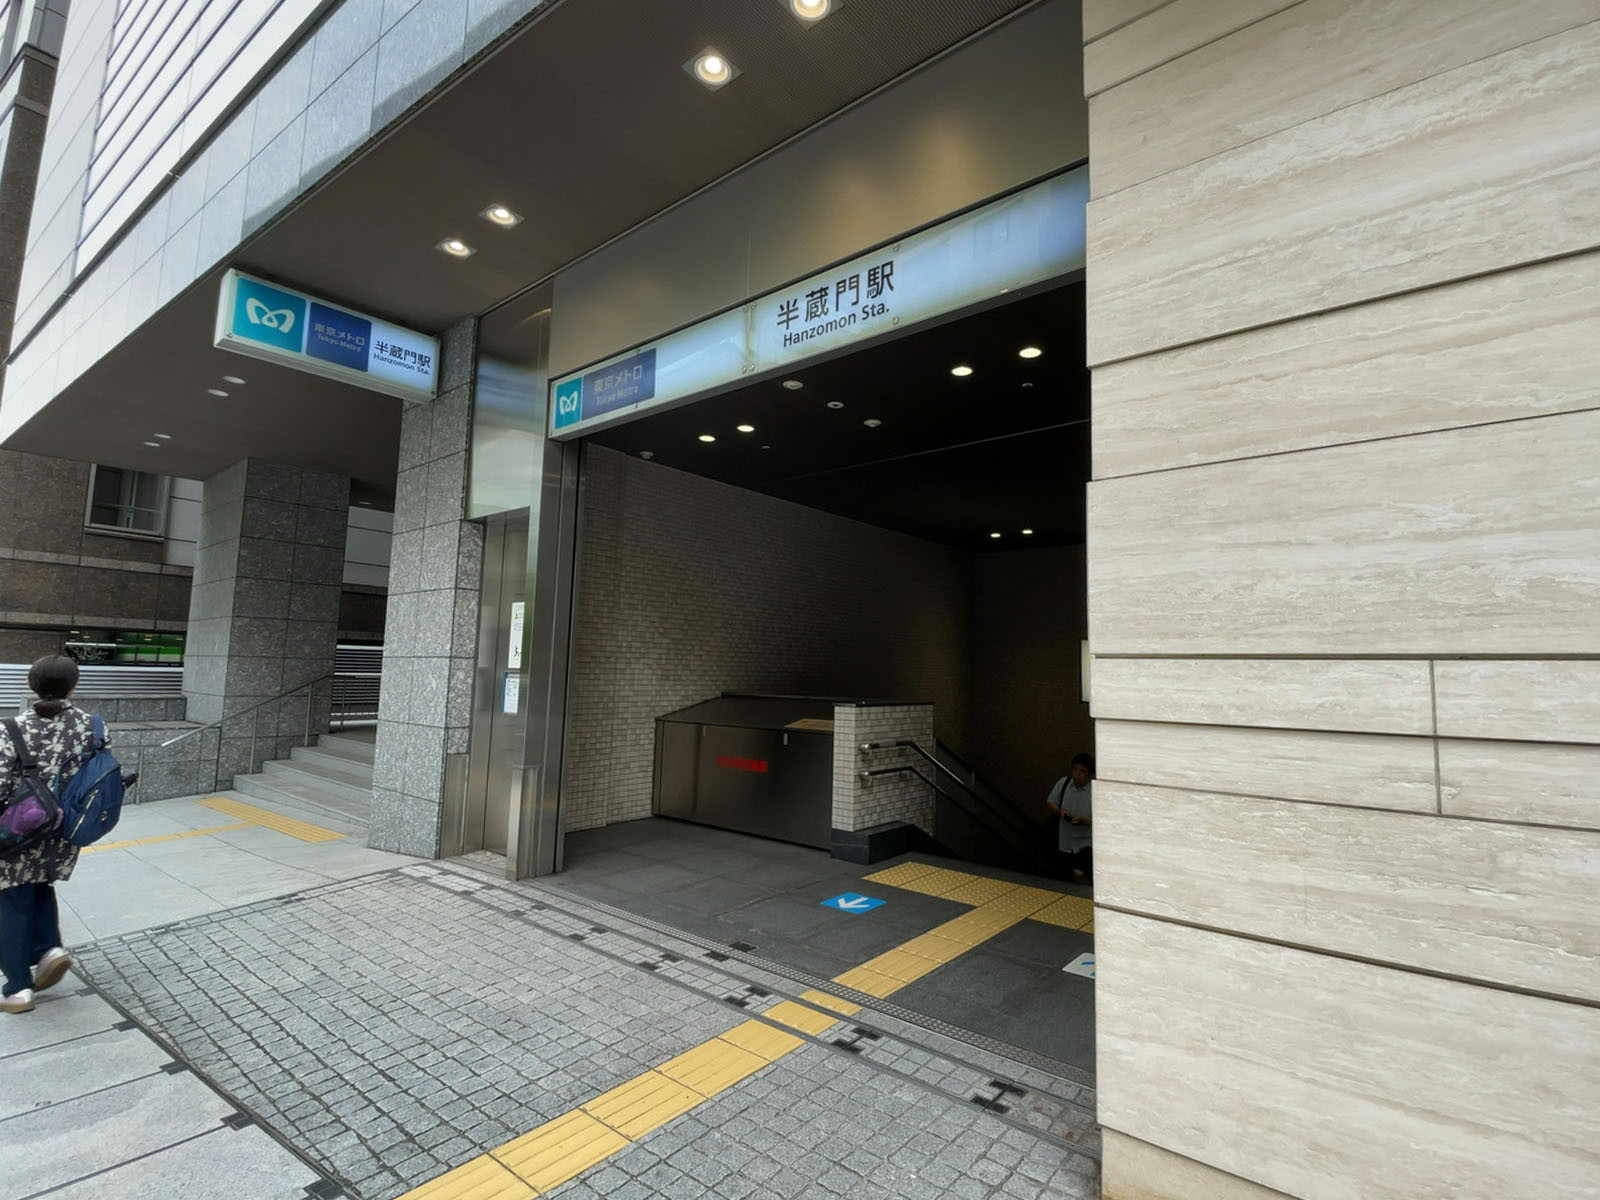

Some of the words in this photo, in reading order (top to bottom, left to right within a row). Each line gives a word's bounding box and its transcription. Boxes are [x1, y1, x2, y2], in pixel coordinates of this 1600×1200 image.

[776, 260, 894, 330] 半蔵門駅
[314, 322, 365, 346] 東京メトロ
[783, 313, 857, 347] Hanzomon
[861, 302, 890, 321] Sta.
[373, 352, 415, 372] Hanzomon
[416, 365, 431, 375] Sta.
[375, 340, 431, 369] 半蔵門駅
